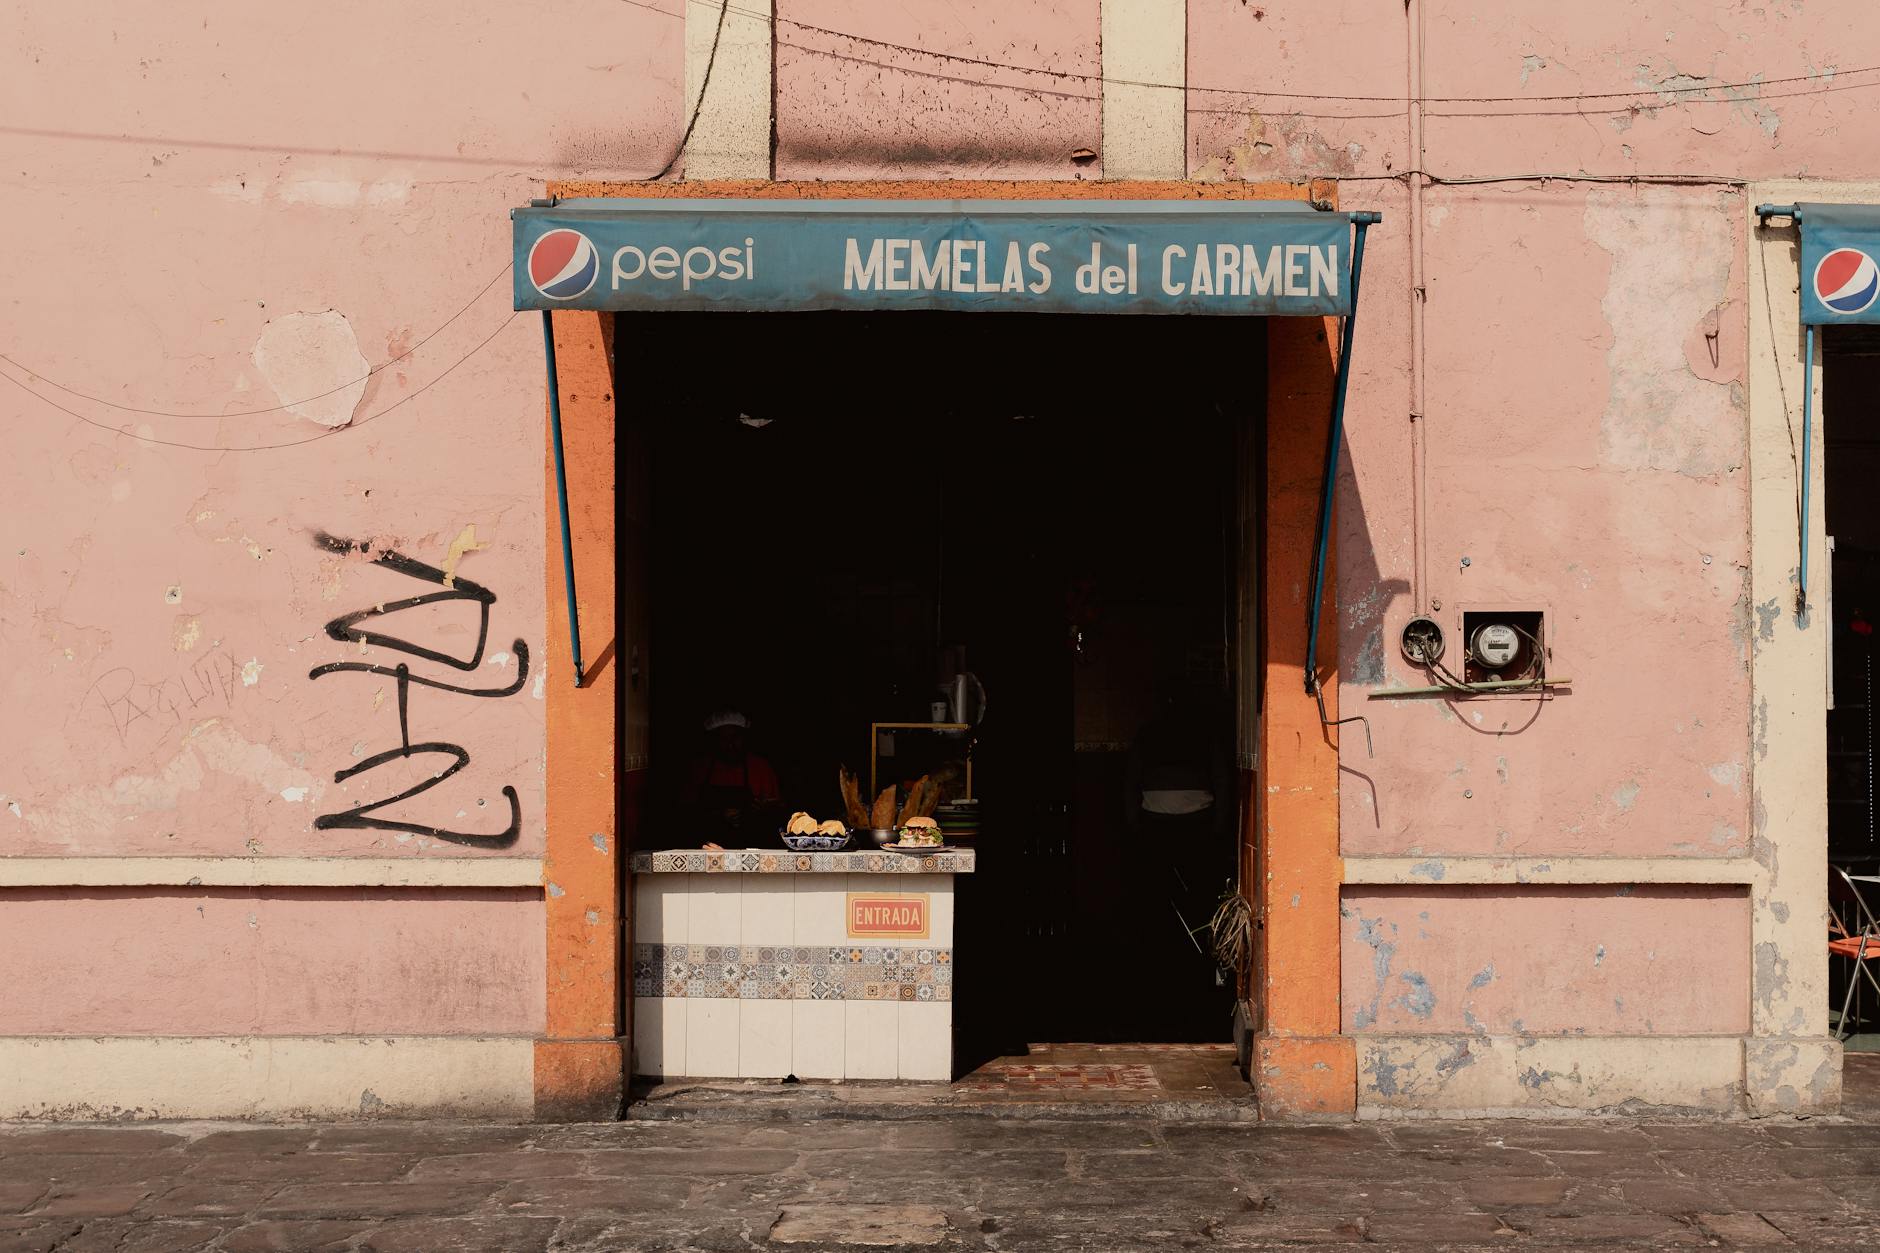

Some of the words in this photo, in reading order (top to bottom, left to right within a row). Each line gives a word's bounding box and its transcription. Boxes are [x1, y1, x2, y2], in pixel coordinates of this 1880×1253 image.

[612, 237, 754, 291] pepsi
[843, 238, 1052, 295] MEMELAS
[1075, 242, 1138, 295] del
[1161, 243, 1338, 297] CARMEN
[855, 906, 921, 926] ENTRADA
